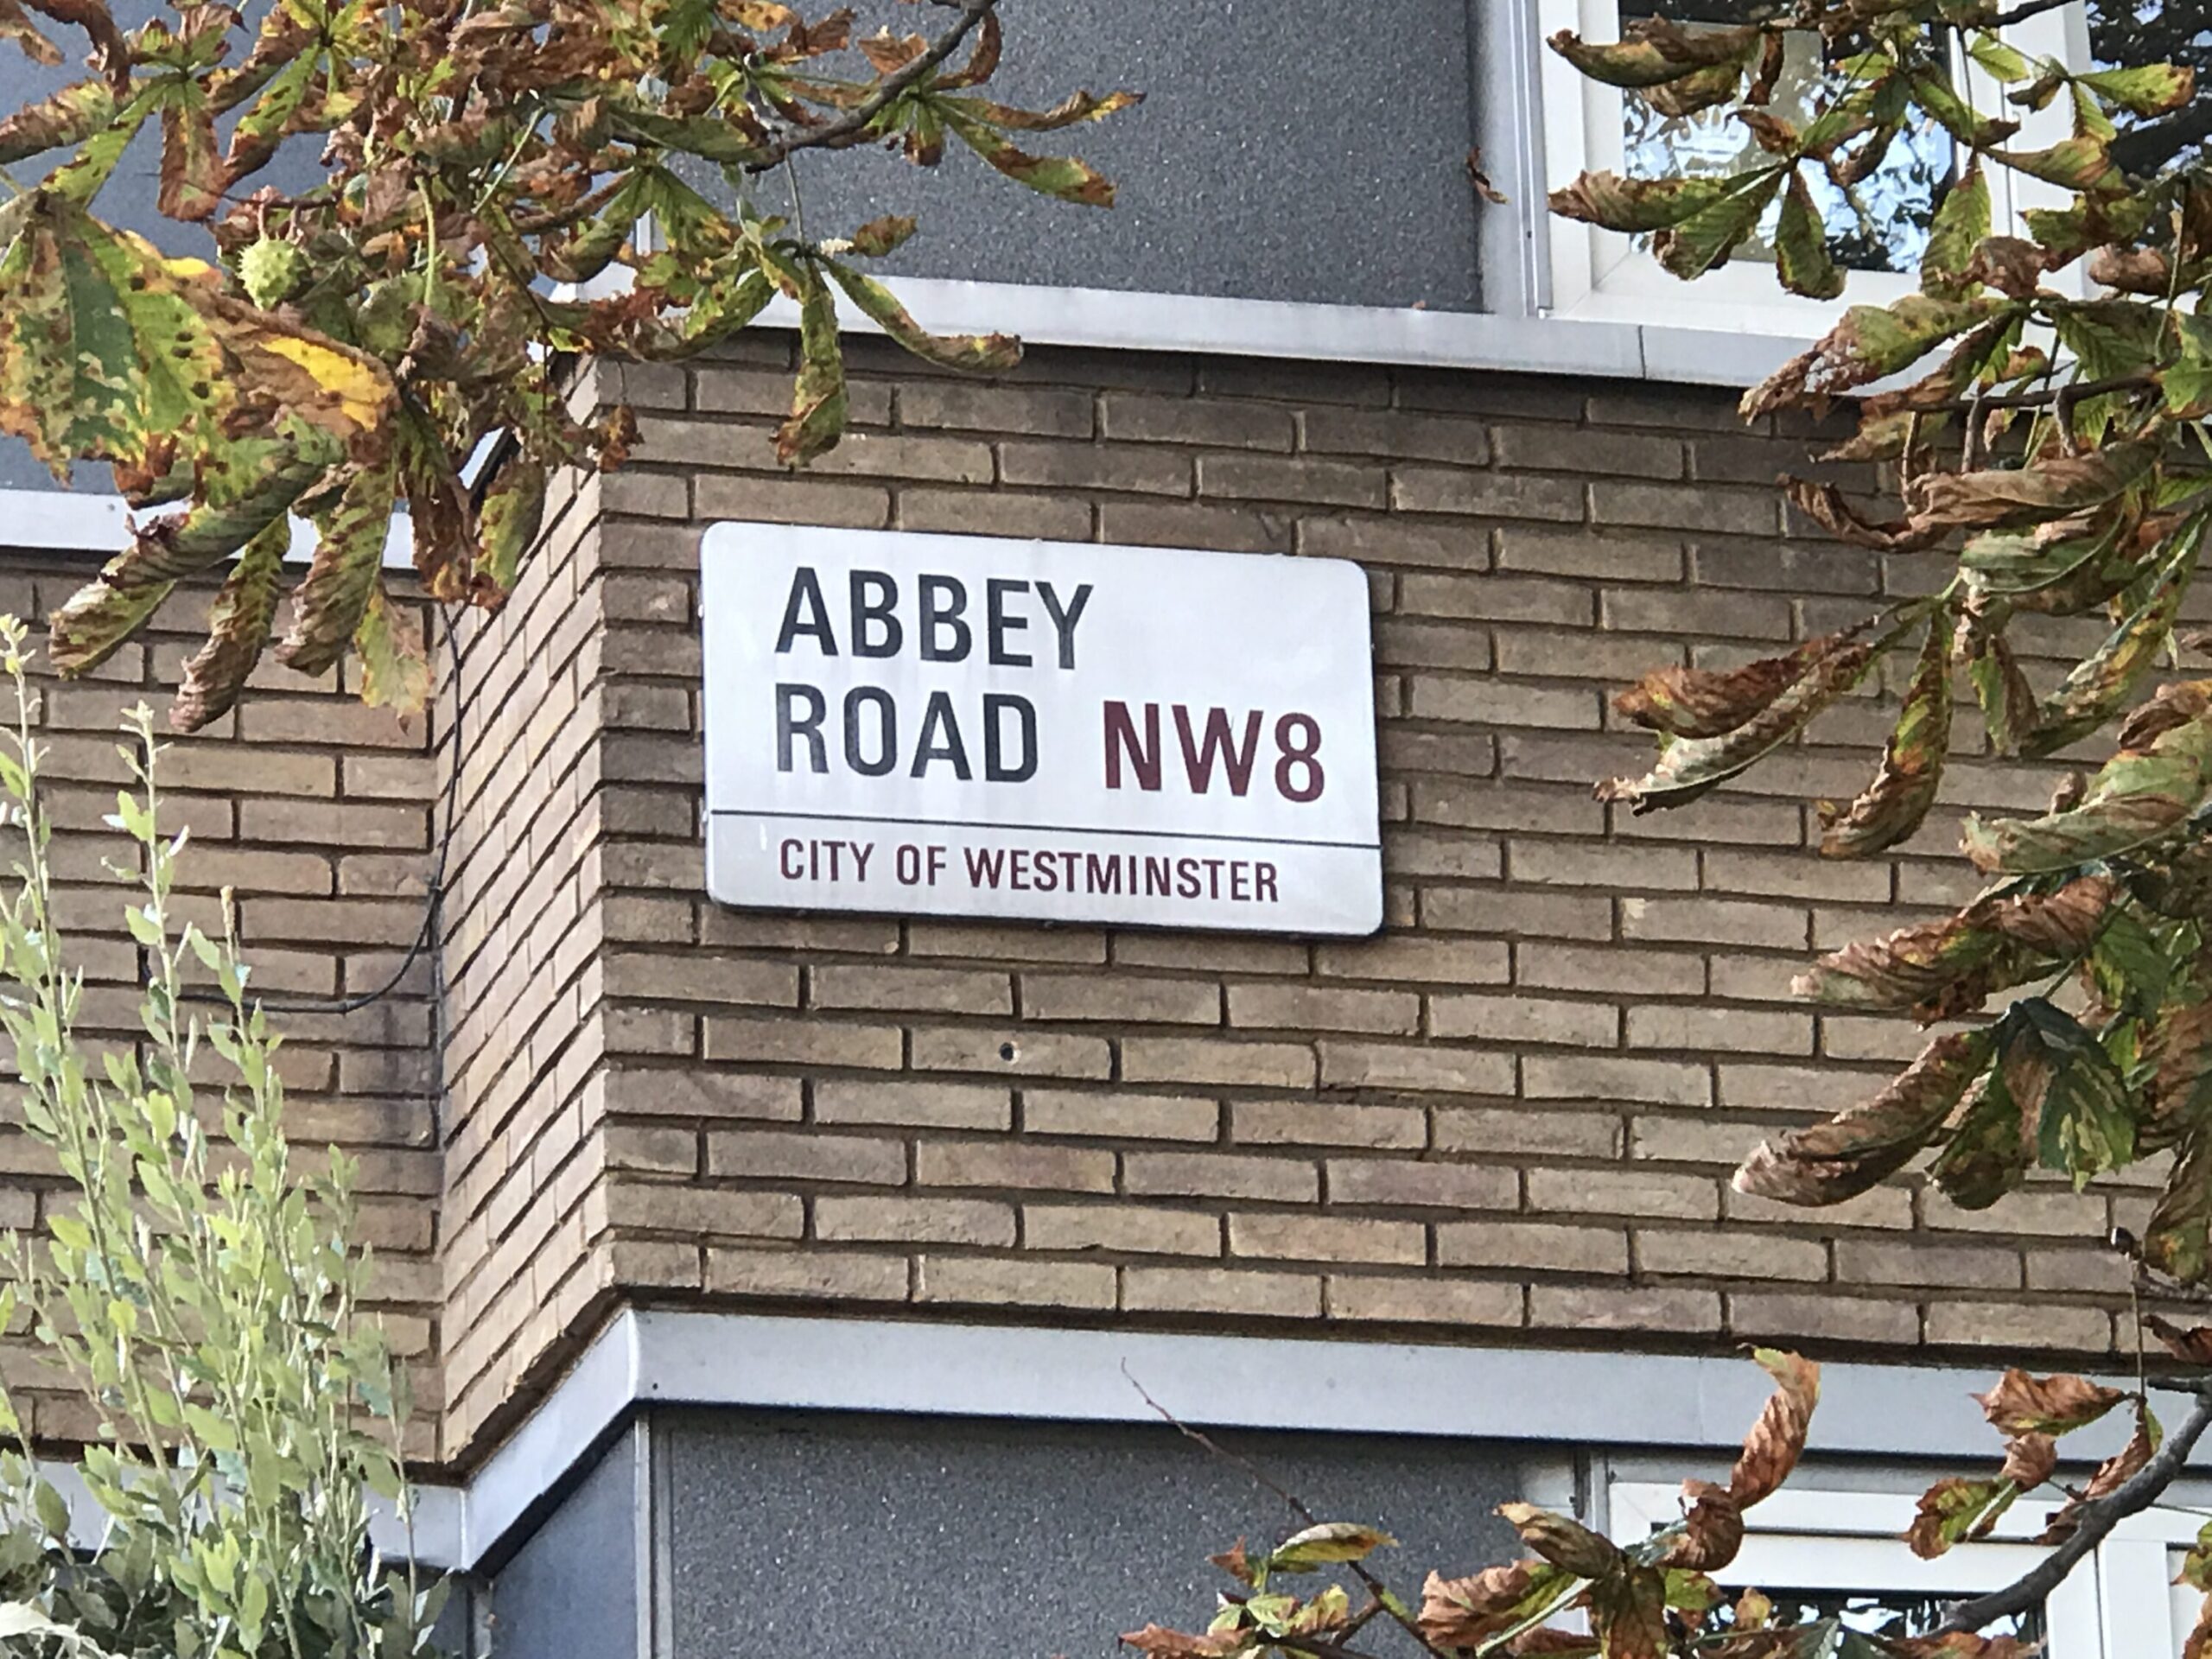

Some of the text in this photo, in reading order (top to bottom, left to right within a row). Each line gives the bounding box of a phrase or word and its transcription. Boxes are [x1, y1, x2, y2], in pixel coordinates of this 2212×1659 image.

[775, 567, 1094, 671] ABBEY
[775, 683, 1325, 803] ROAD NW8
[780, 838, 1279, 903] CITY OF WESTMINSTER
